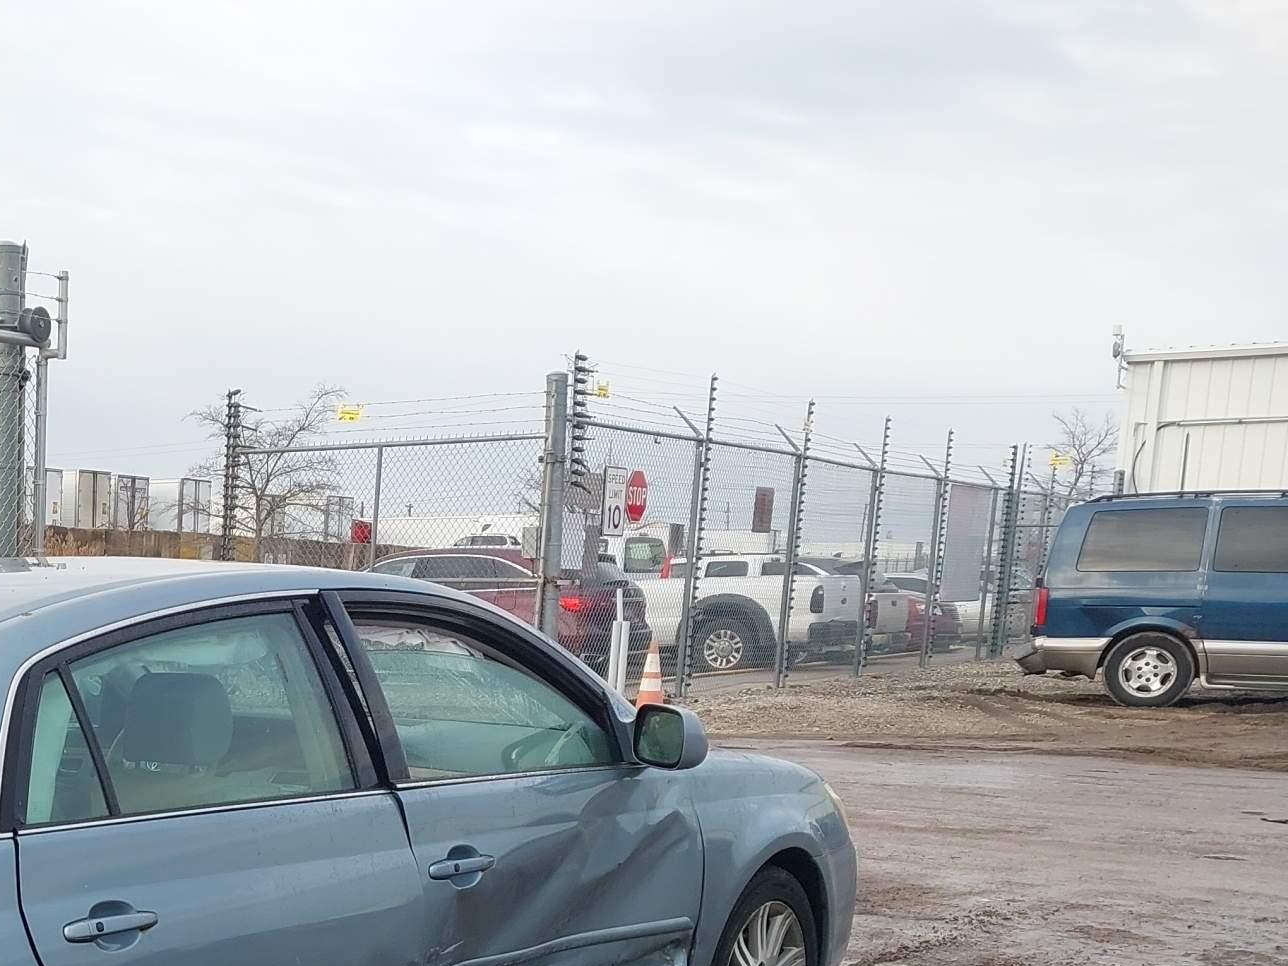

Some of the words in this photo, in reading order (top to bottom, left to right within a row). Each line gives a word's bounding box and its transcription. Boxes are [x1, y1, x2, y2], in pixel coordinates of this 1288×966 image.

[608, 473, 625, 485] SPEED
[608, 487, 623, 499] LIMIT
[628, 486, 647, 506] STOP
[607, 504, 621, 530] 10
